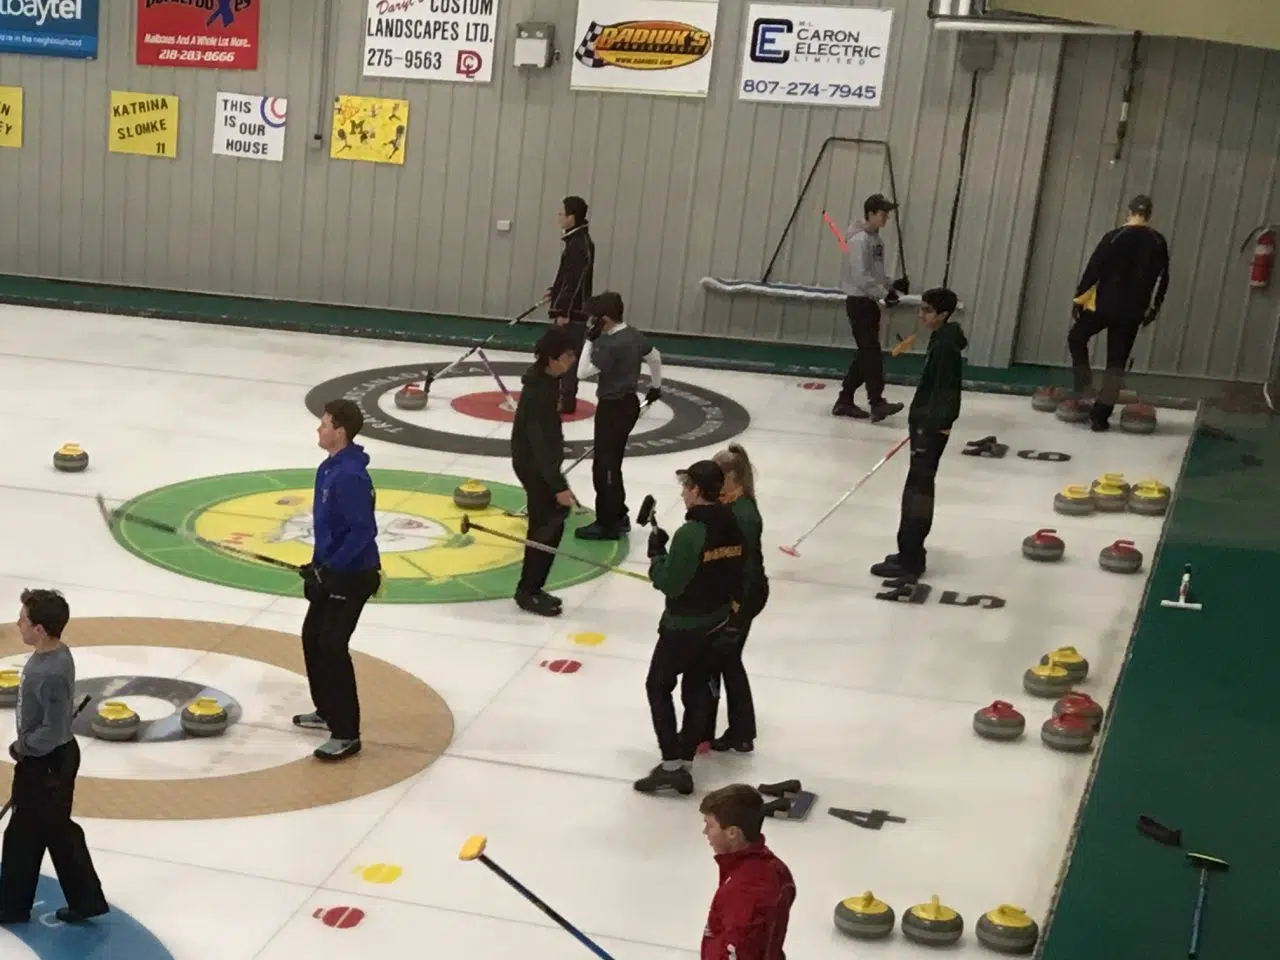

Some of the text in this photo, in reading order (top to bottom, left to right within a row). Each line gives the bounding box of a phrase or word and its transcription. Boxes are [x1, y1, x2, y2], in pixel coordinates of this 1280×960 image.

[430, 0, 493, 15] CUSTOM
[367, 18, 493, 43] LANDSCAPES LTD.
[797, 29, 860, 43] CARON
[795, 42, 880, 58] ELECTRIC
[367, 48, 442, 70] 275-9563
[743, 79, 876, 99] 807-274-7945
[113, 98, 168, 117] KATRINA
[222, 99, 251, 114] THIS
[224, 115, 266, 137] IS OUR
[349, 119, 364, 135] M
[156, 142, 166, 154] 11
[226, 140, 268, 155] HOUSE
[939, 590, 1006, 609] 5
[827, 806, 907, 830] 4
